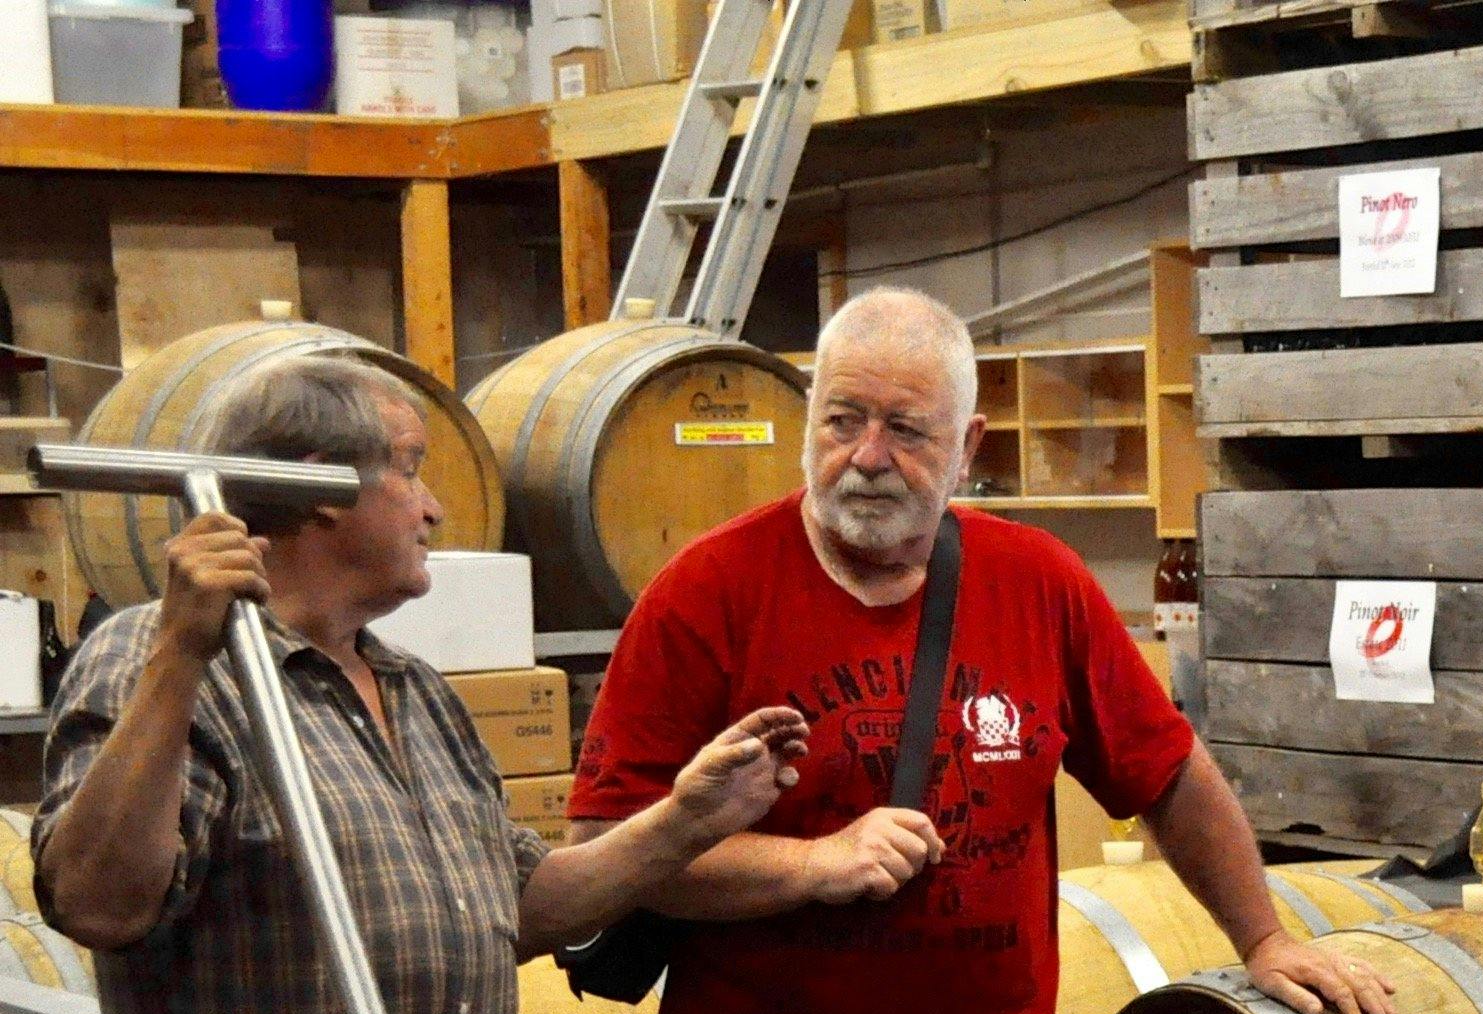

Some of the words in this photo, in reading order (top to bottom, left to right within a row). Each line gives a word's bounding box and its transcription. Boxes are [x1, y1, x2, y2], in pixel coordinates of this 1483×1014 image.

[1360, 195, 1391, 214] Pinot
[1348, 600, 1385, 621] Pinot
[1389, 601, 1419, 621] Noir
